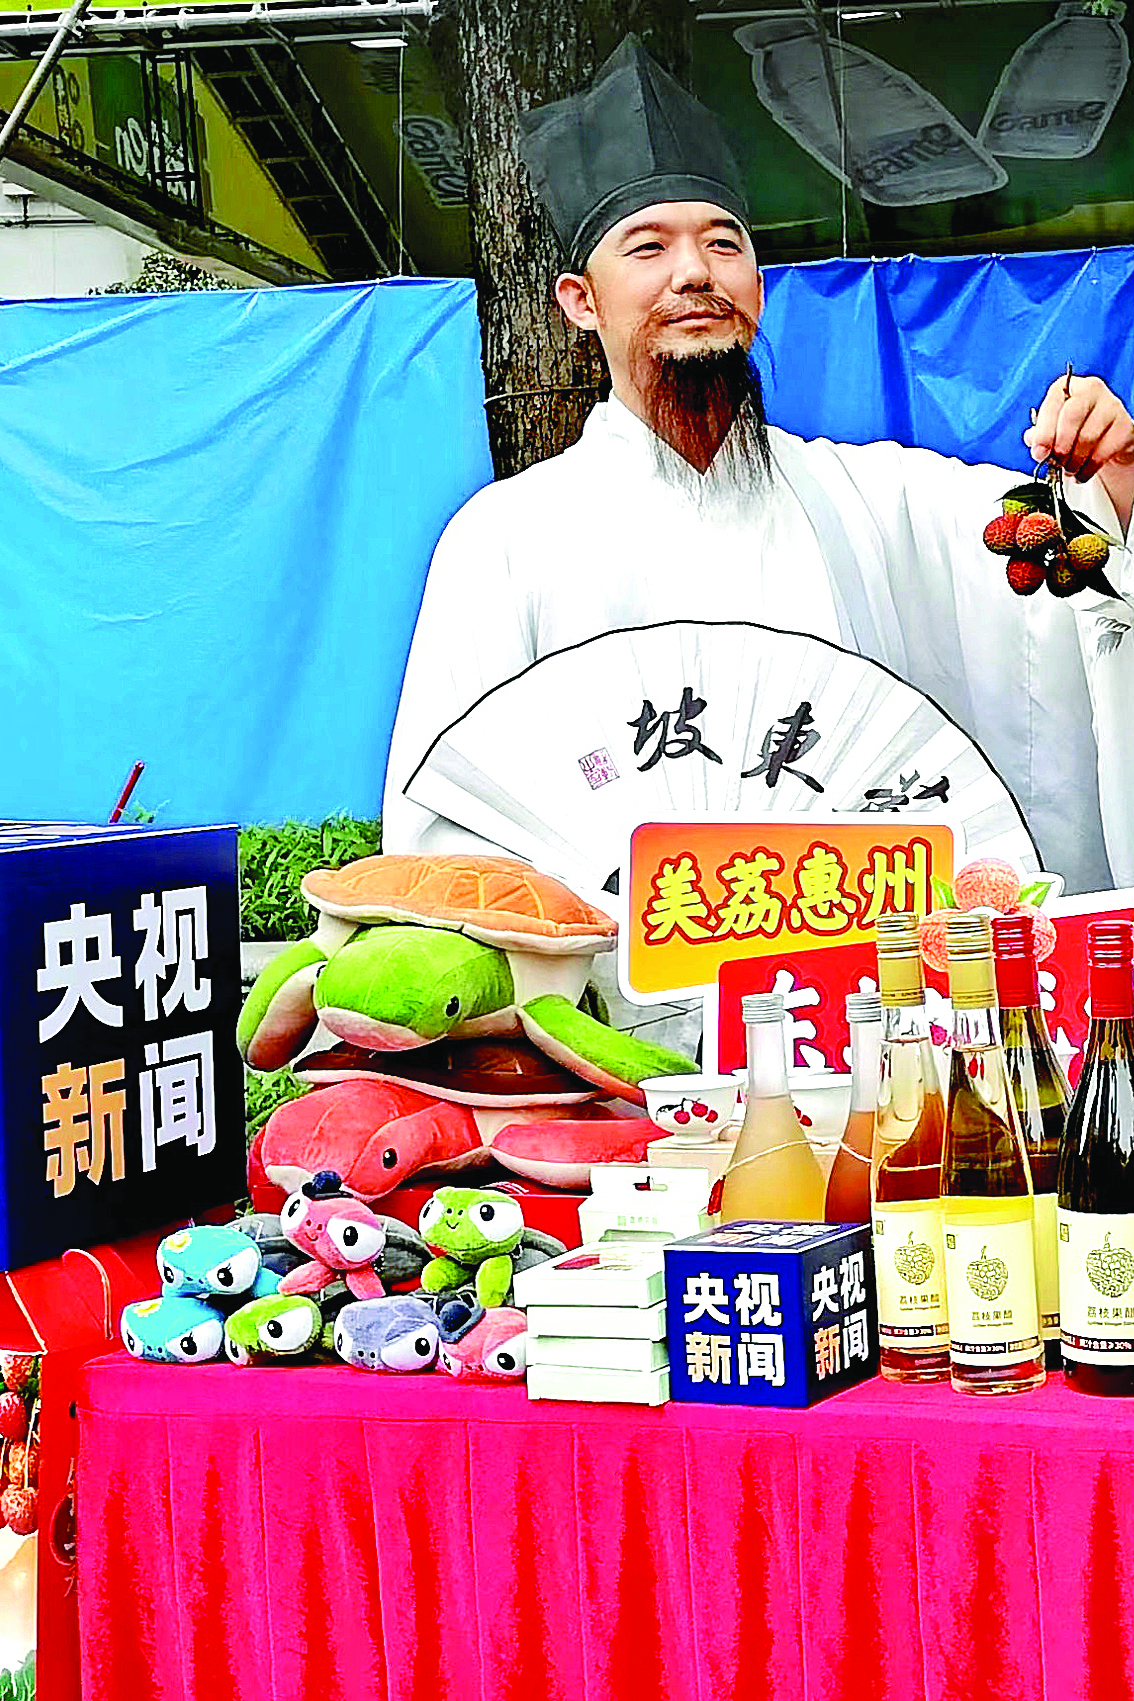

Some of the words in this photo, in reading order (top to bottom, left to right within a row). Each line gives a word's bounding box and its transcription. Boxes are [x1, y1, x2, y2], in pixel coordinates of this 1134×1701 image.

[647, 843, 927, 939] 美荔惠州
[37, 885, 212, 1043] 央视
[41, 1030, 217, 1198] 新闻
[683, 1272, 782, 1326] 央视
[812, 1252, 866, 1322] 央视
[685, 1331, 786, 1387] 新闻
[813, 1309, 869, 1381] 新闻
